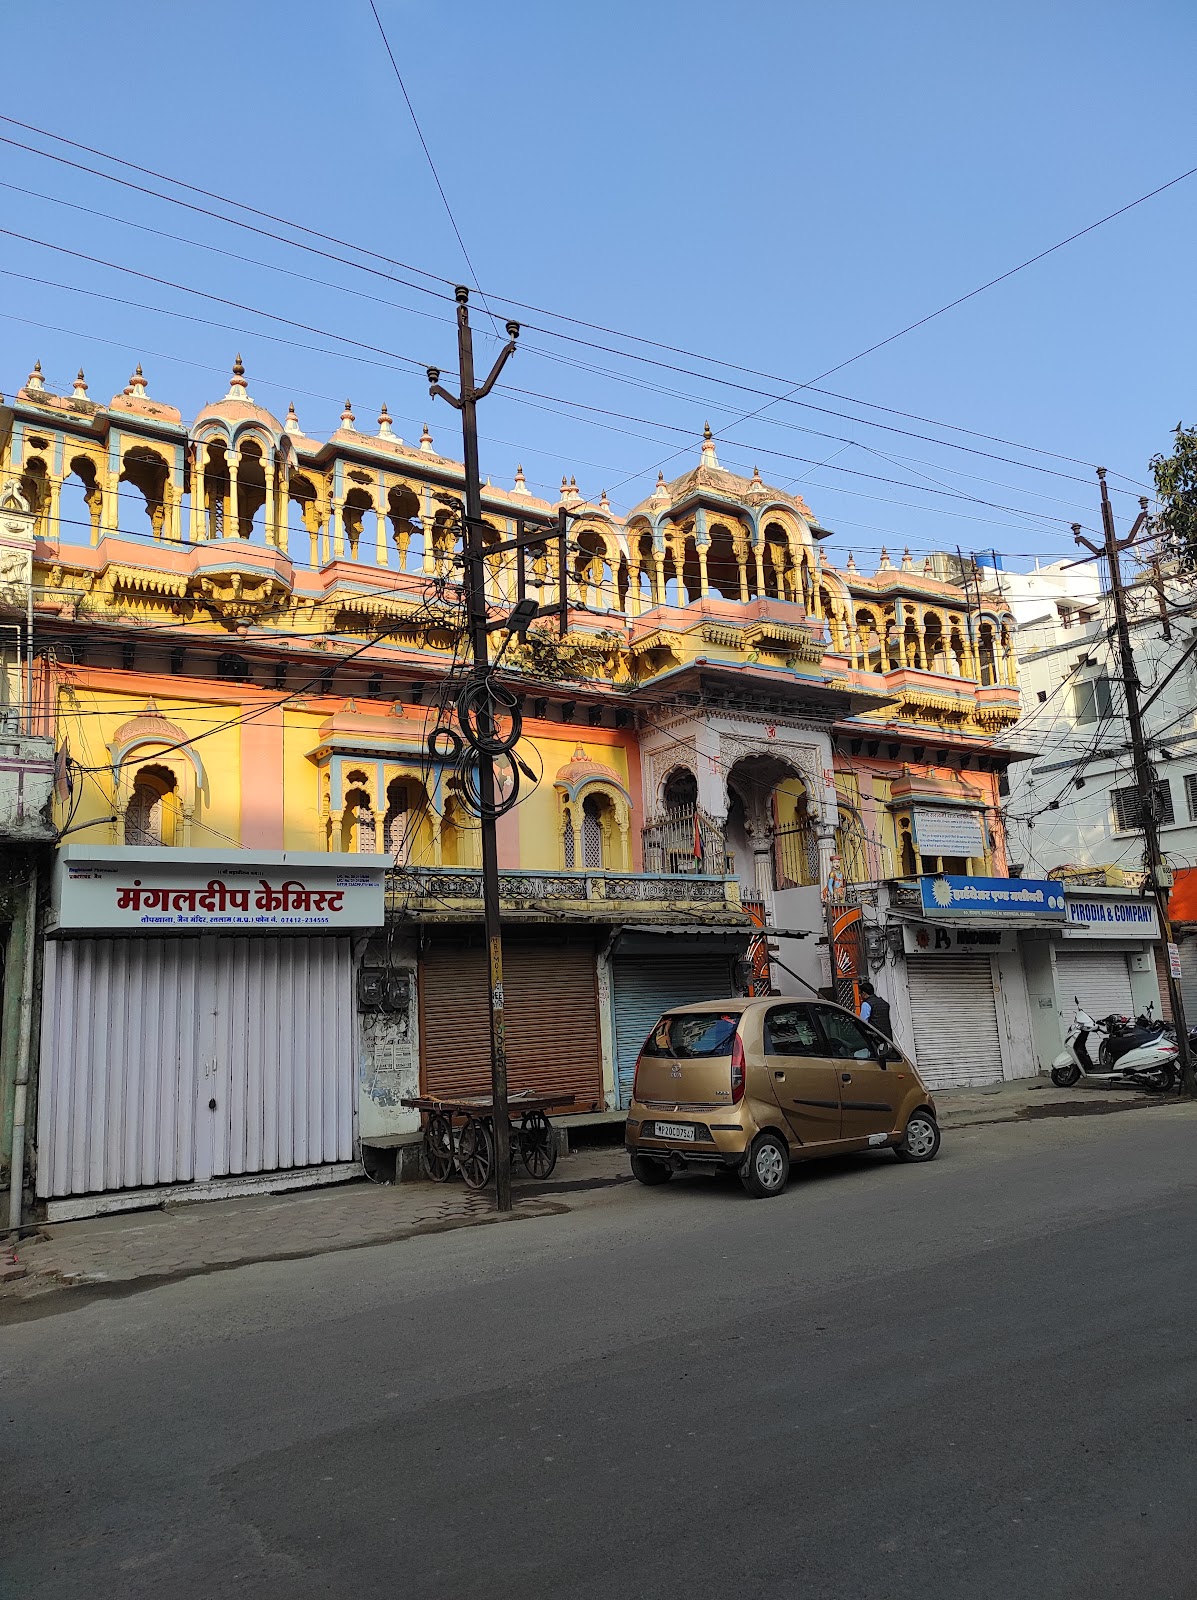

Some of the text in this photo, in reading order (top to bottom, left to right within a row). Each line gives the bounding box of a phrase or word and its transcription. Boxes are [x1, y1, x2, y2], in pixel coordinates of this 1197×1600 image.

[116, 879, 344, 912] मंगलदीप केमिस्ट
[140, 914, 176, 924] तोपखाना,
[177, 914, 189, 923] जैन
[209, 915, 232, 923] रतलाम
[255, 914, 269, 923] फोन
[1070, 904, 1152, 922] PIRODIA & COMPANY
